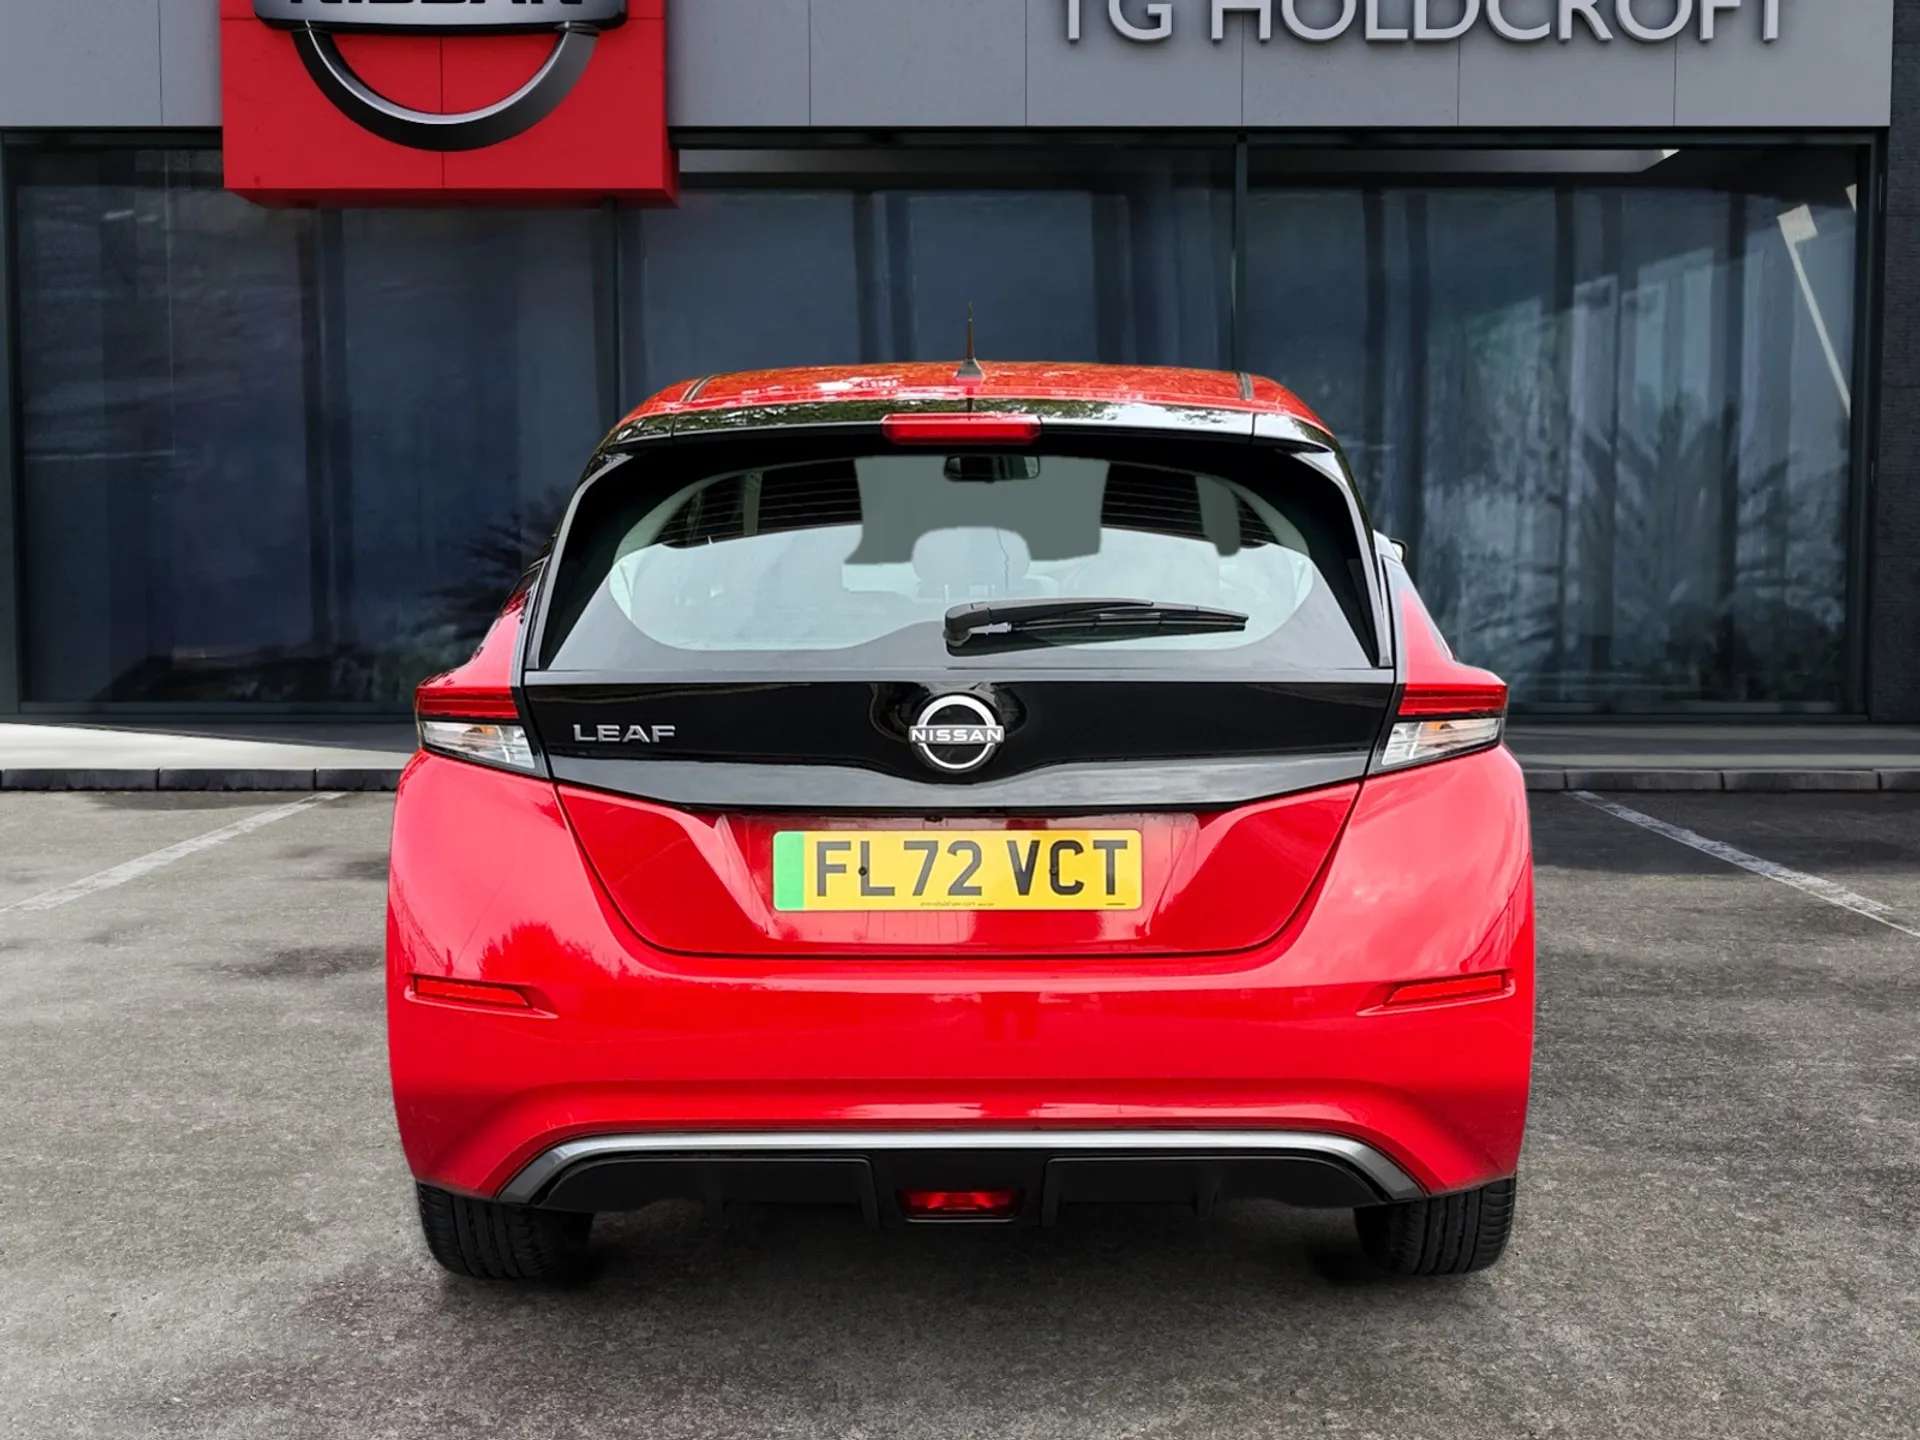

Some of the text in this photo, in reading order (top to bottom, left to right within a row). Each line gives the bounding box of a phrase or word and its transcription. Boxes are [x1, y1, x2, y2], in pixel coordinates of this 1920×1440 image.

[572, 724, 676, 743] LEAF
[910, 727, 1004, 743] NISSAN
[816, 839, 1128, 897] FL72 VCT
